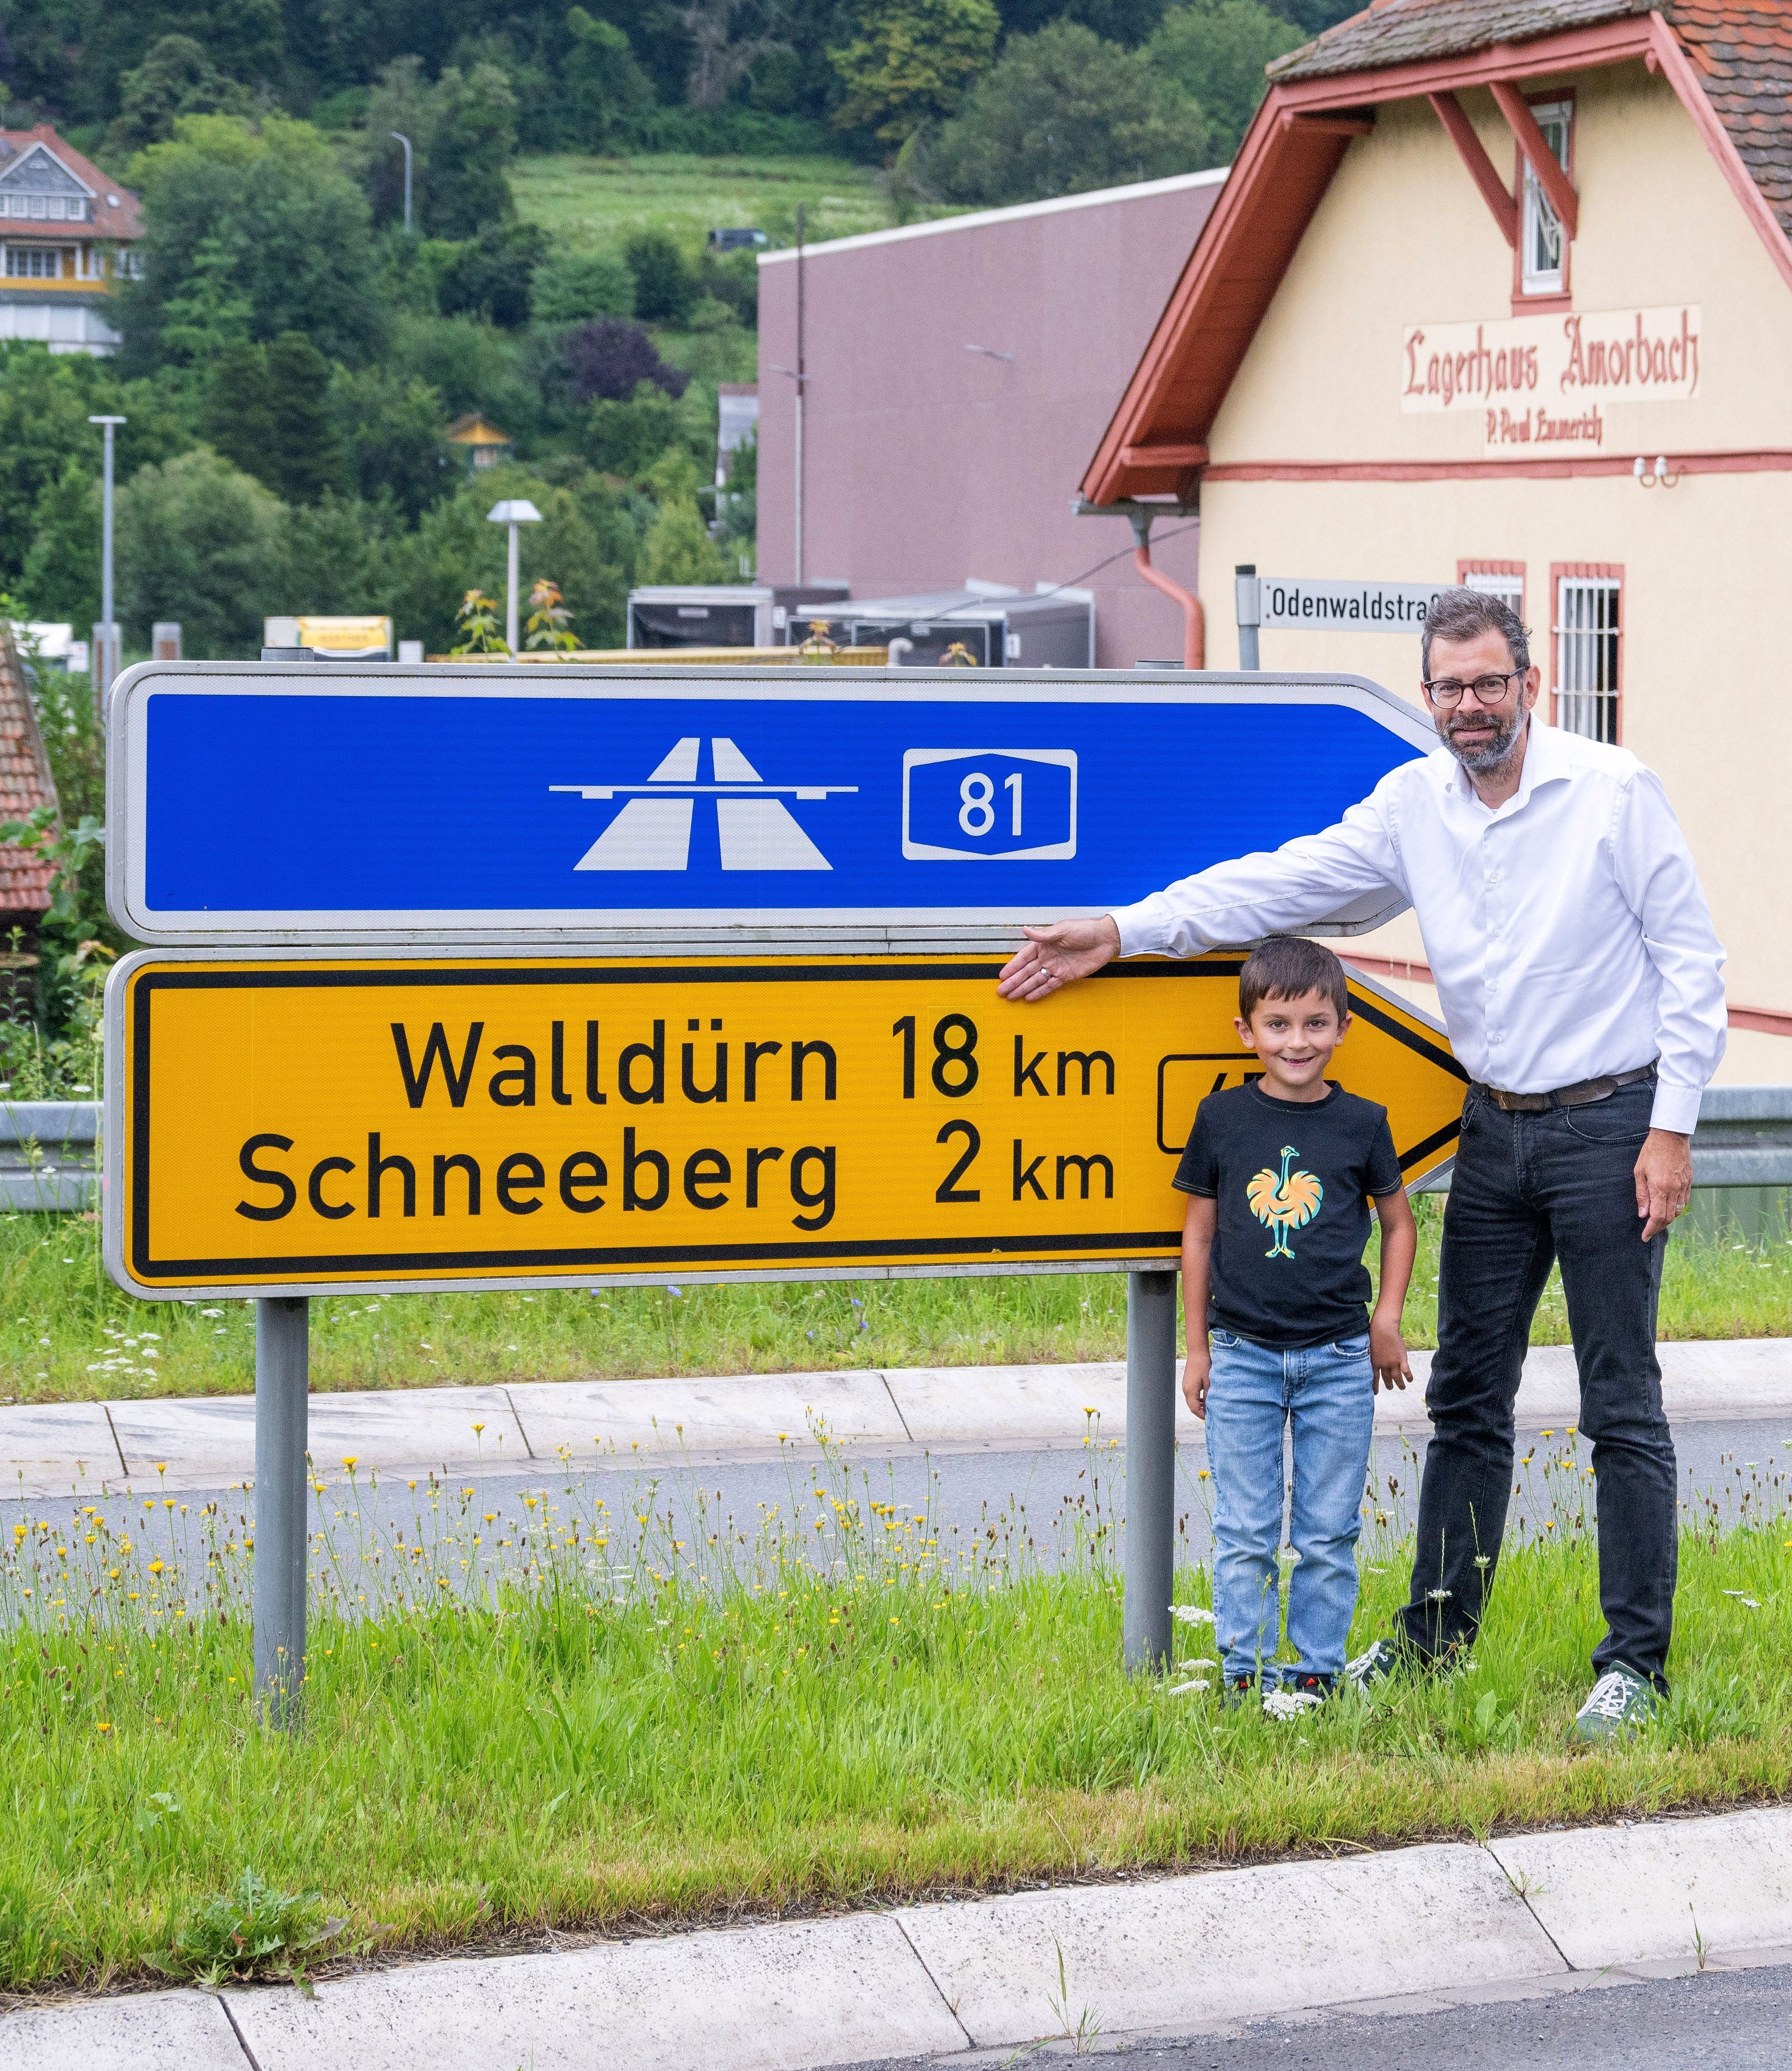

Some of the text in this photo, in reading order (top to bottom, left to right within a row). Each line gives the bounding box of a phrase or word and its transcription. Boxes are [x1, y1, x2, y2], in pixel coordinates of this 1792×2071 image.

[1404, 309, 1698, 406] Lagerhaus Amorbach
[1500, 407, 1531, 443] Paul
[958, 772, 1023, 837] 81
[390, 1013, 1115, 1109] Walldürn 18 km
[235, 1119, 1114, 1231] Schneeberg 2 km
